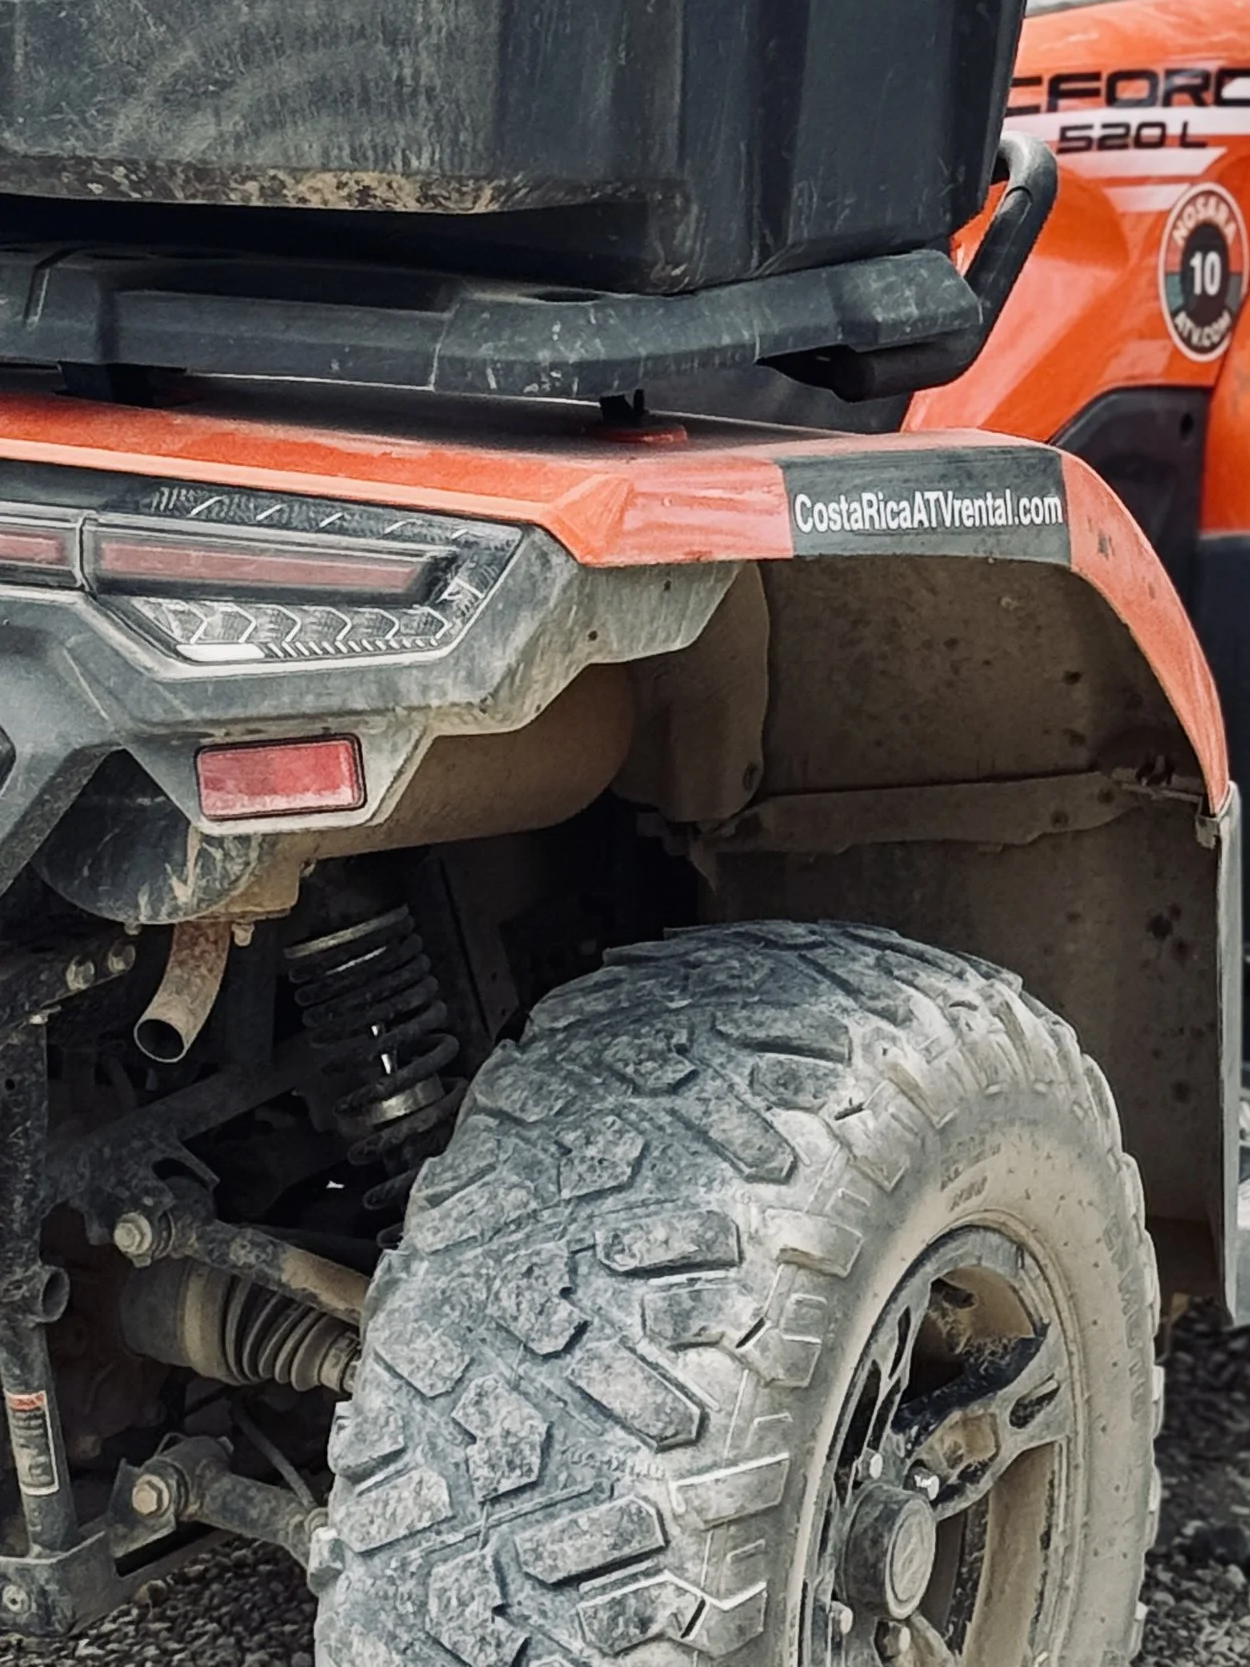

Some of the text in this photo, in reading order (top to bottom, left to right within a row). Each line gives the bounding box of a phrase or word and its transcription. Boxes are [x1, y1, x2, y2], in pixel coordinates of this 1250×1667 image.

[1057, 121, 1208, 154] 520 L
[1173, 195, 1236, 247] NOSARA
[1189, 251, 1222, 296] 10
[795, 489, 1063, 534] CostaRicaATVrental.com
